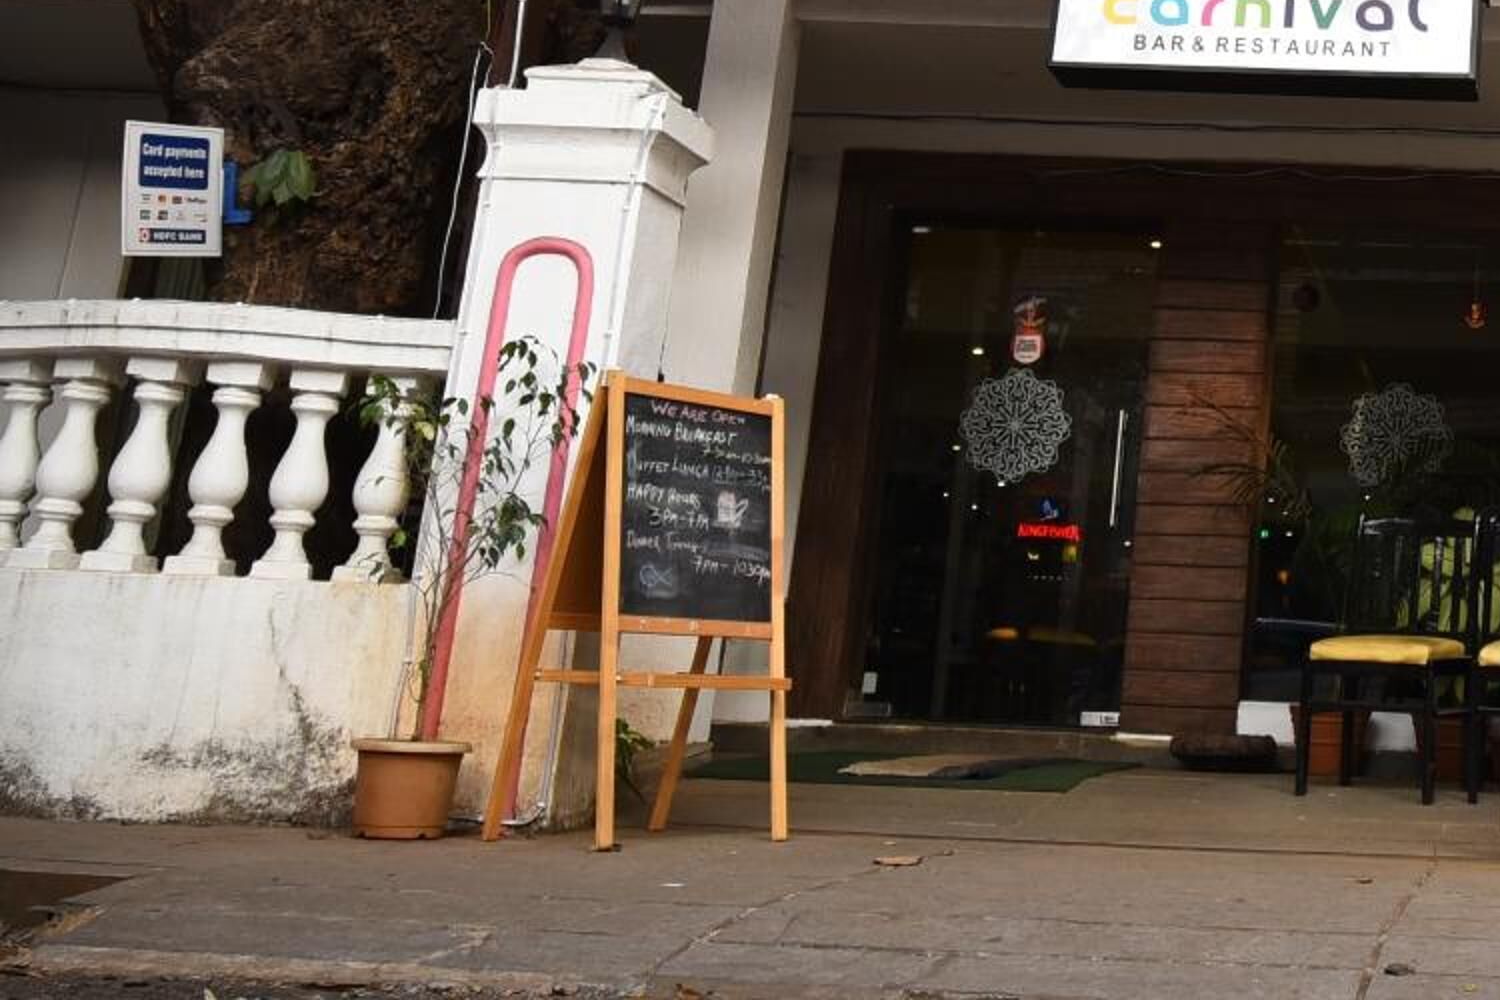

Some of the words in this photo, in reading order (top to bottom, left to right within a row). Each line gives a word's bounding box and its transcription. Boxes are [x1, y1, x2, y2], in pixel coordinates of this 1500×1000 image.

[1133, 34, 1184, 52] BAR
[1192, 36, 1204, 53] &
[1215, 36, 1392, 57] RESTAURANT
[143, 143, 163, 157] Card
[165, 146, 207, 160] payments
[143, 165, 183, 179] accepted
[184, 166, 205, 179] here
[153, 231, 176, 241] HDFC
[178, 231, 204, 241] BANK
